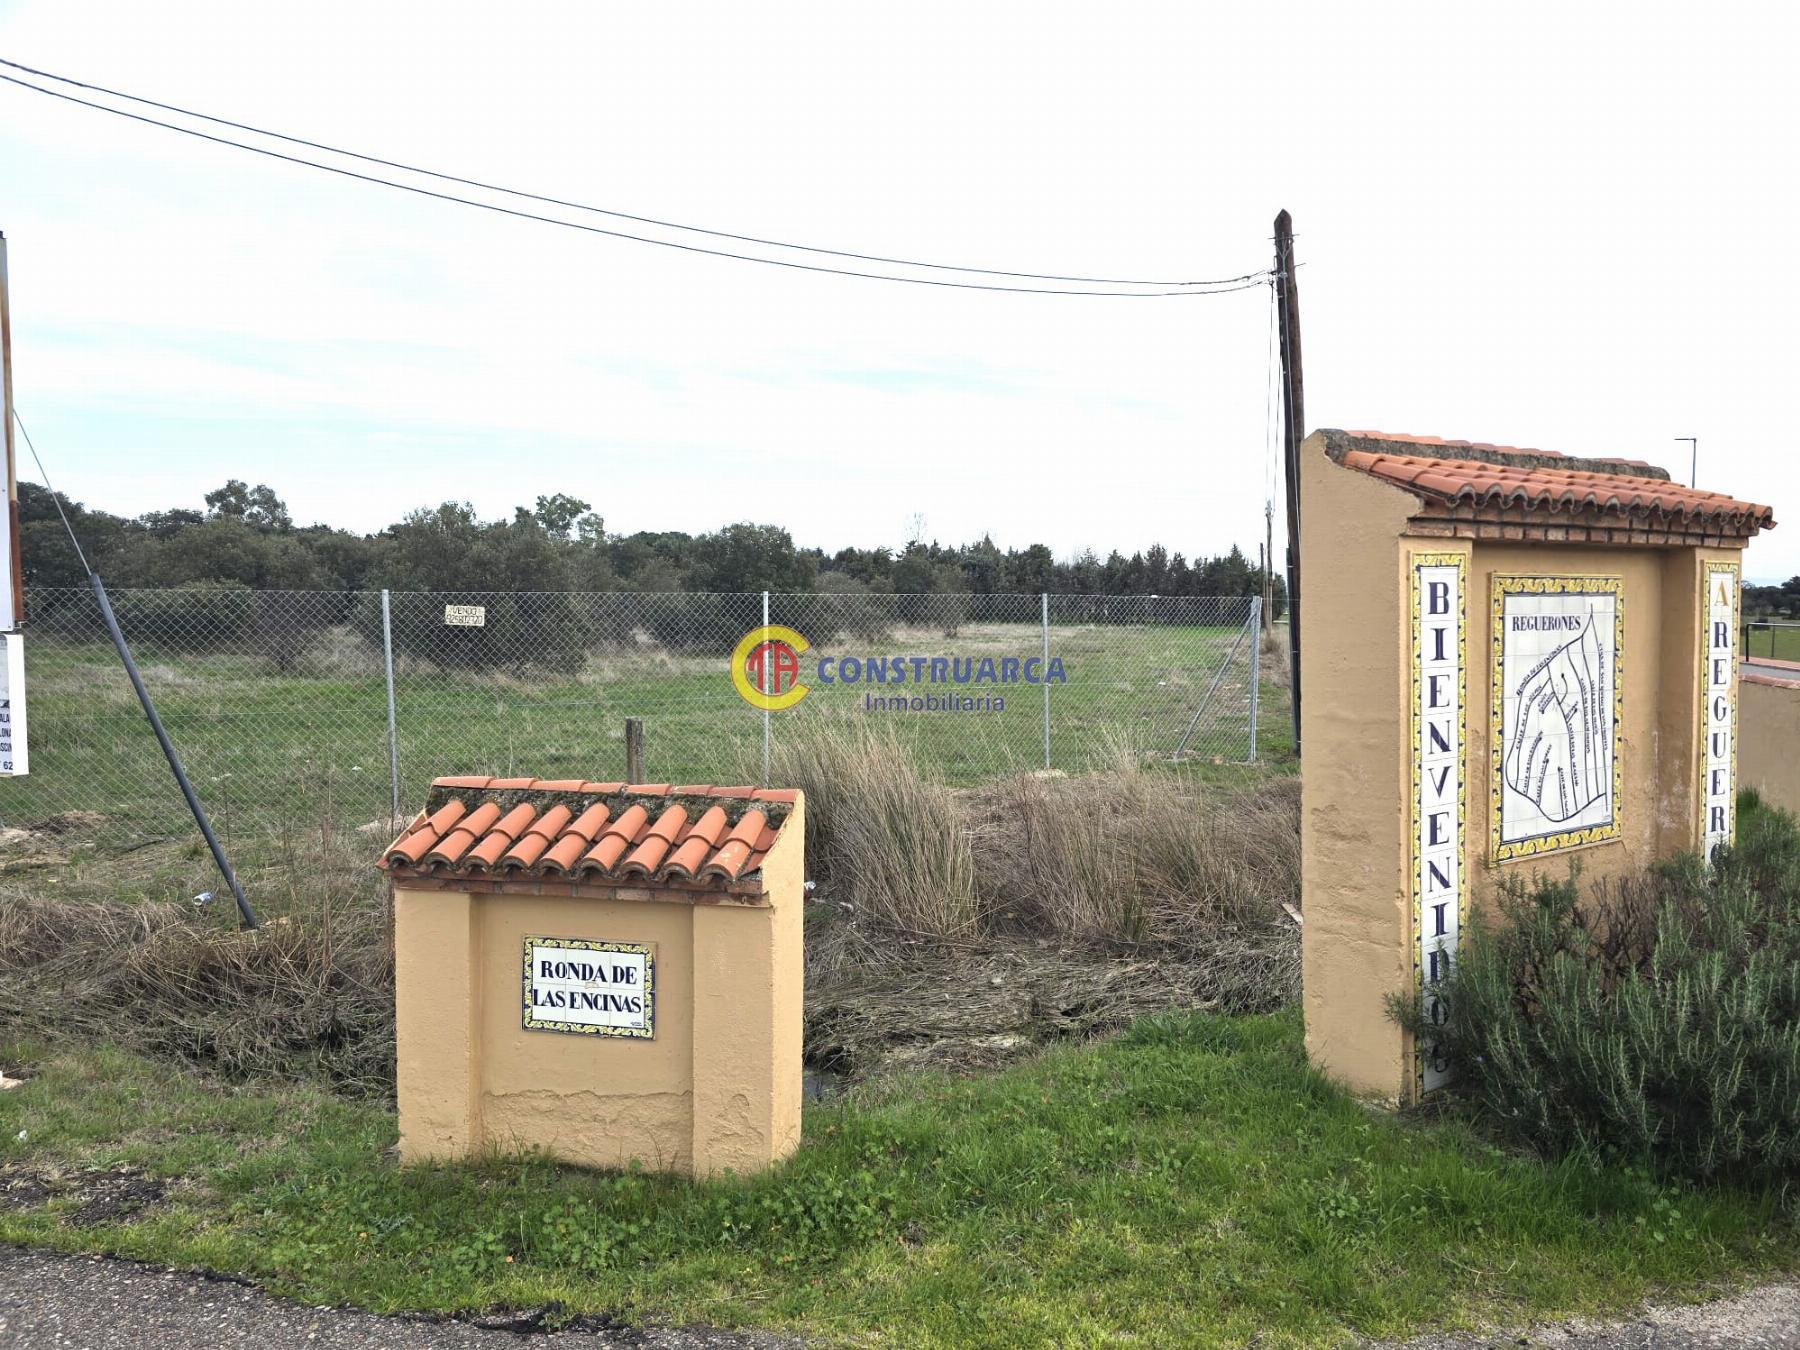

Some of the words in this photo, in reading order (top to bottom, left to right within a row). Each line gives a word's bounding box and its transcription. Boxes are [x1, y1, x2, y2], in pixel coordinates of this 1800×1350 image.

[1714, 580, 1729, 607] A
[1512, 616, 1581, 632] REGUERONES
[540, 960, 608, 983] RONDA
[612, 965, 637, 985] DE
[533, 988, 566, 1008] LAS
[569, 991, 642, 1014] ENCINAS
